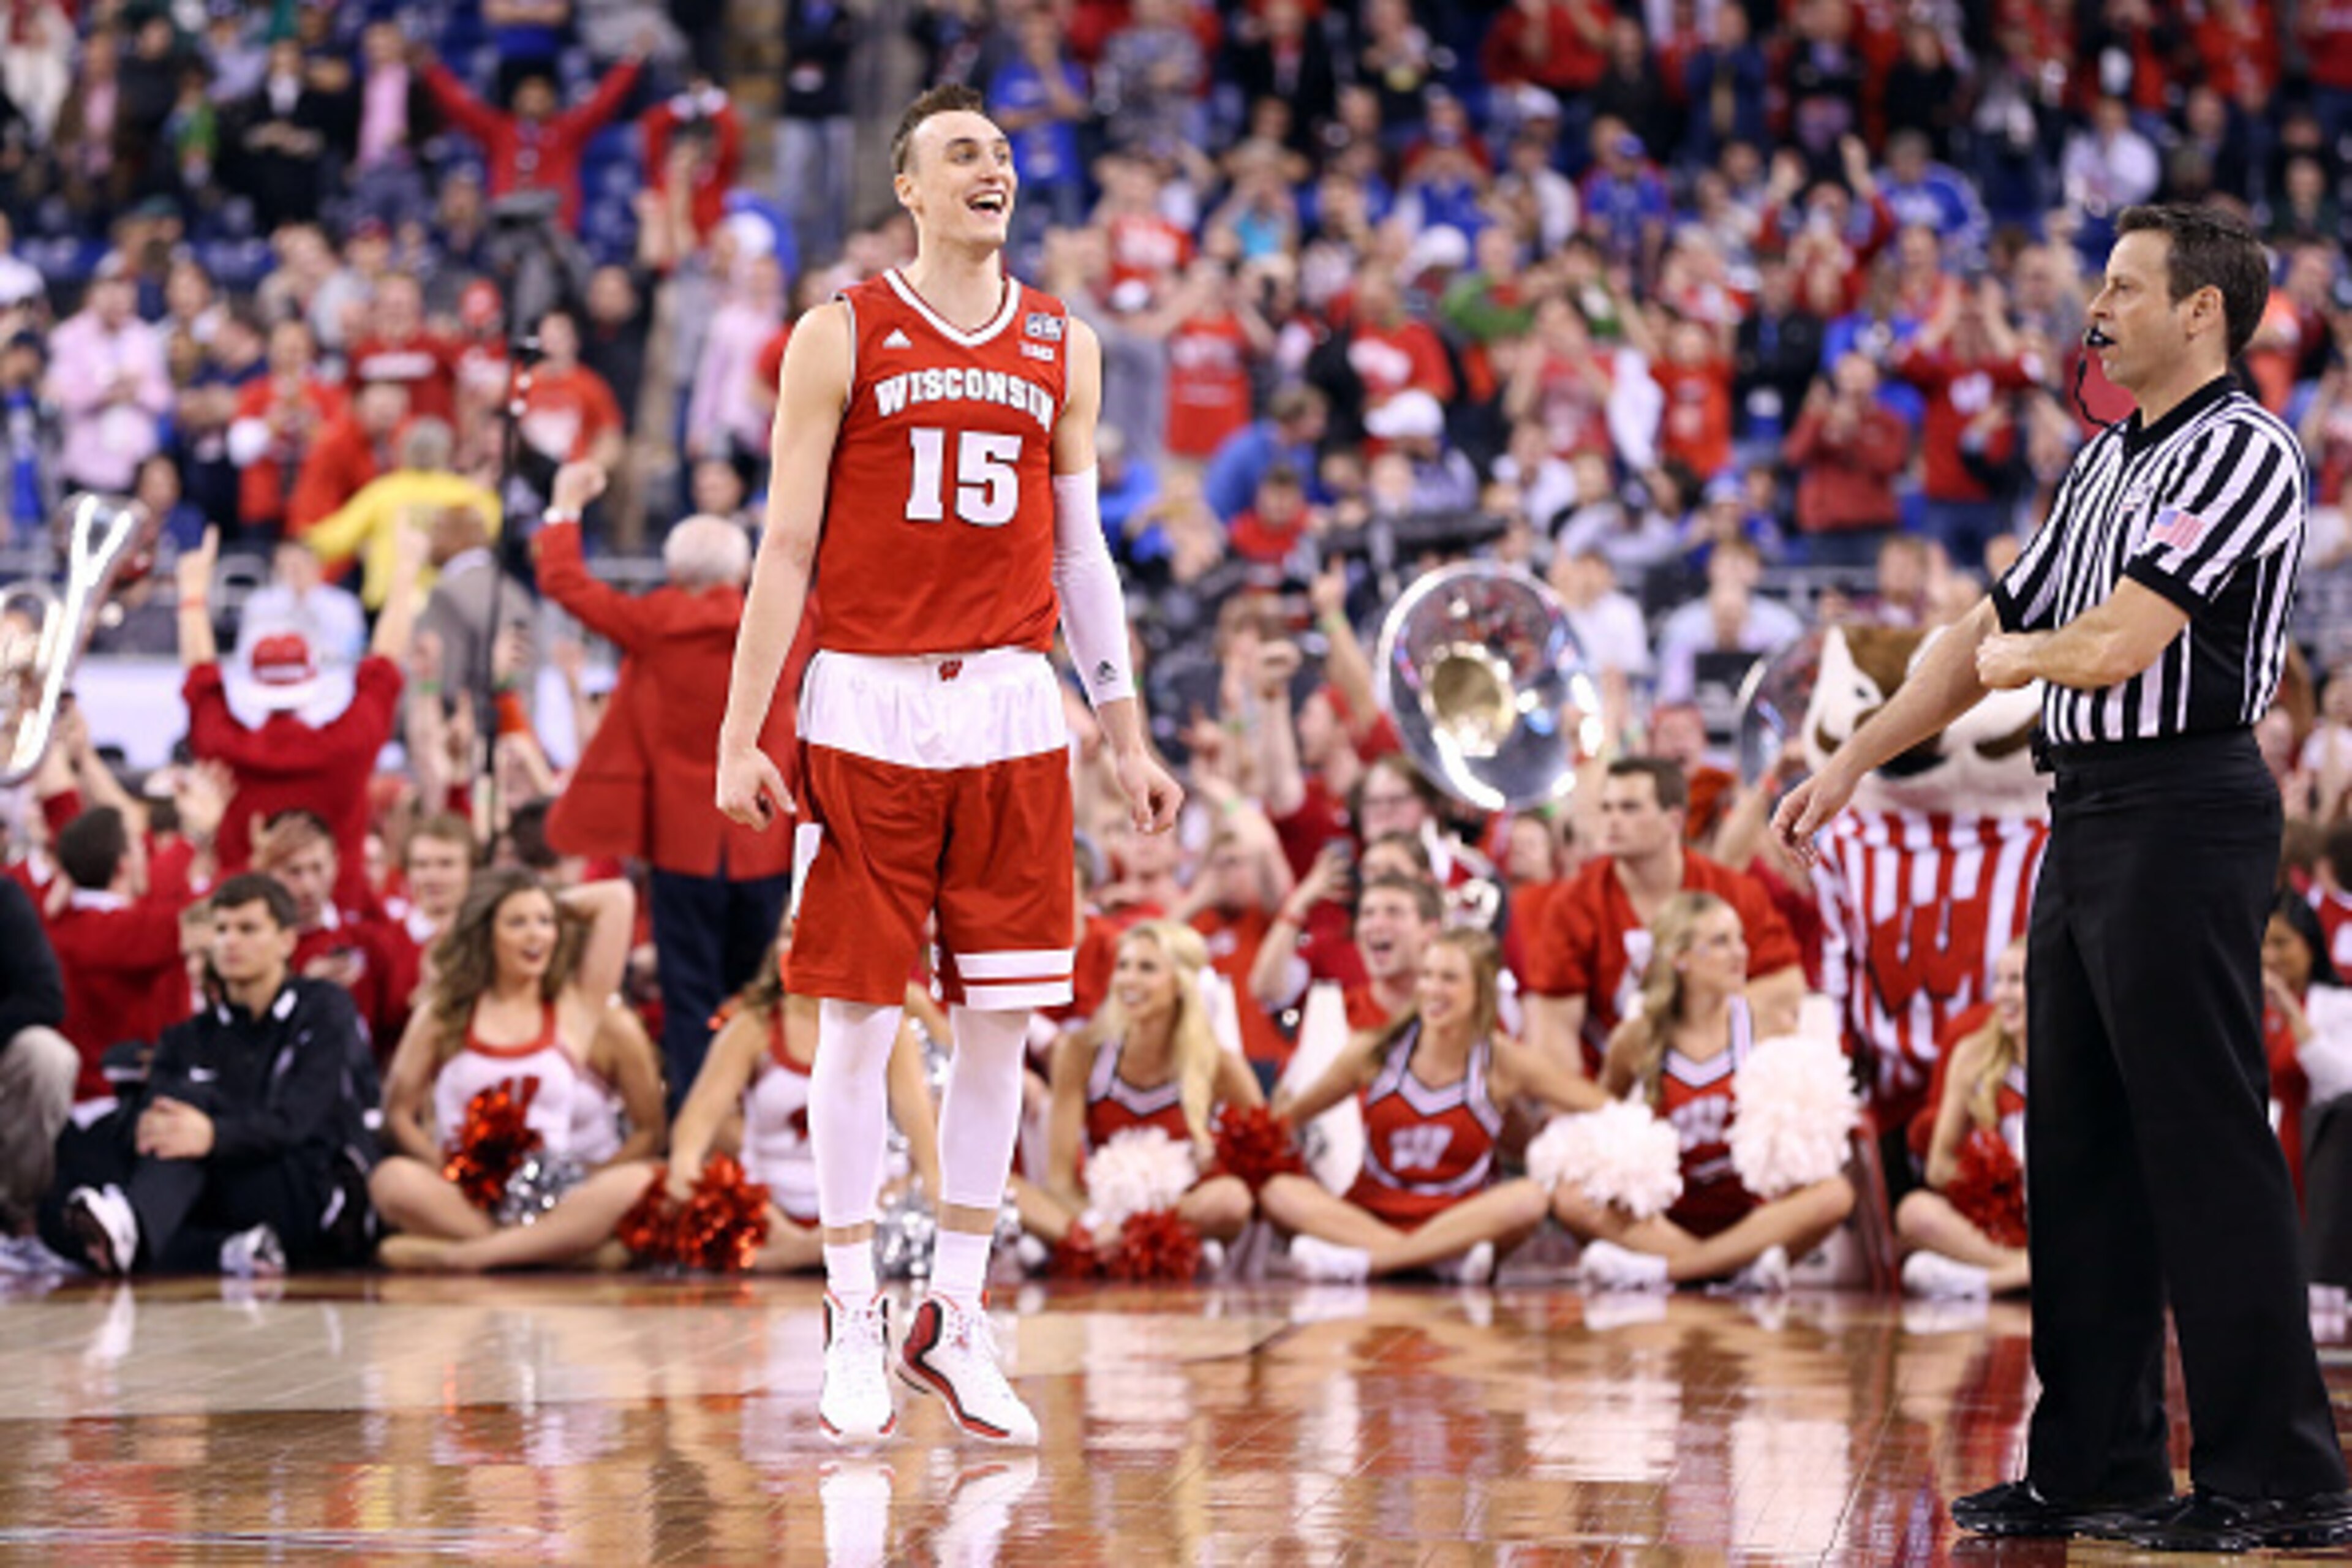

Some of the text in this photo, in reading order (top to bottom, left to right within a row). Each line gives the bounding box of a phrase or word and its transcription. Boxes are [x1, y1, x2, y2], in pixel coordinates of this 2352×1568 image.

[875, 368, 1054, 432] WISCONSIN
[905, 428, 1022, 526] 15
[1866, 897, 1988, 1019] W
[1389, 1125, 1454, 1171] W
